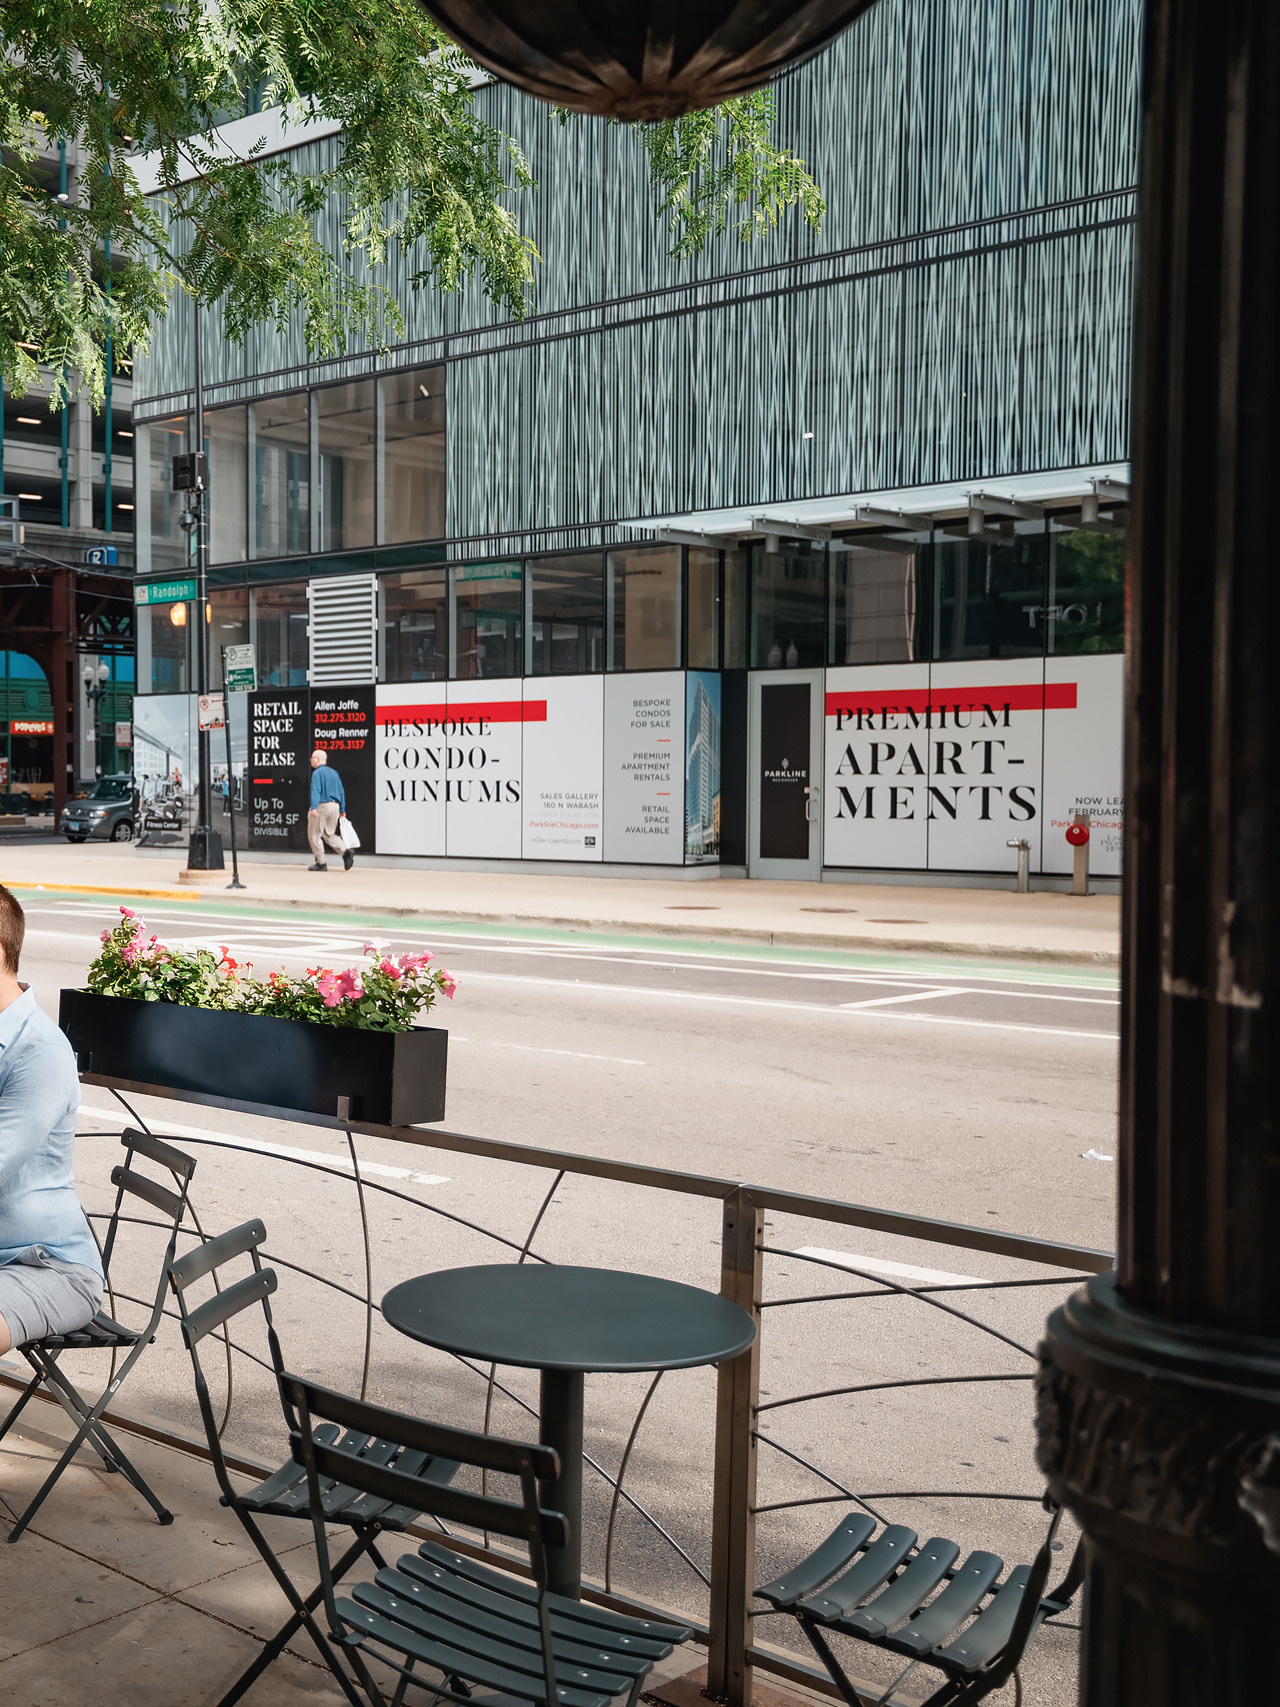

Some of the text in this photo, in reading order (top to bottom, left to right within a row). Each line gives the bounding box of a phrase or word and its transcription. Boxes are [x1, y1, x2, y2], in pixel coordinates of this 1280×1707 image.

[152, 584, 189, 599] Randolph
[314, 700, 359, 711] Allen Joffe
[633, 699, 671, 707] BESPOKE
[253, 701, 302, 717] RETAIL
[635, 710, 671, 718] CONDOS
[314, 713, 366, 723] 312.275.3120
[835, 702, 1012, 731] PREMIUM
[253, 719, 294, 733] SPACE
[384, 716, 491, 738] BESPOKE
[650, 720, 671, 728] SALE
[314, 728, 368, 739] Doug Renner
[253, 736, 280, 749] FOR
[314, 740, 365, 750] 312.275.3137
[253, 752, 295, 766] LEASE
[384, 746, 500, 769] CONDO-
[633, 752, 671, 760] PREMIUM
[834, 740, 1024, 776] APART-
[621, 763, 670, 771] APARTMENT
[634, 773, 670, 781] RENTALS
[764, 770, 806, 778] PARKLINE
[384, 779, 520, 803] MINIUMS
[254, 798, 284, 810] Up To
[833, 785, 1036, 821] MENTS
[1075, 797, 1126, 805] NOW LEA
[642, 805, 670, 813] RETAIL
[254, 813, 299, 826] 6,254 SF
[644, 816, 670, 824] SPACE
[146, 821, 179, 829] Fitness Center
[529, 821, 599, 829] ParklineChicago.com
[625, 826, 670, 834] AVAILABLE
[254, 827, 288, 836] DIVISIBLE
